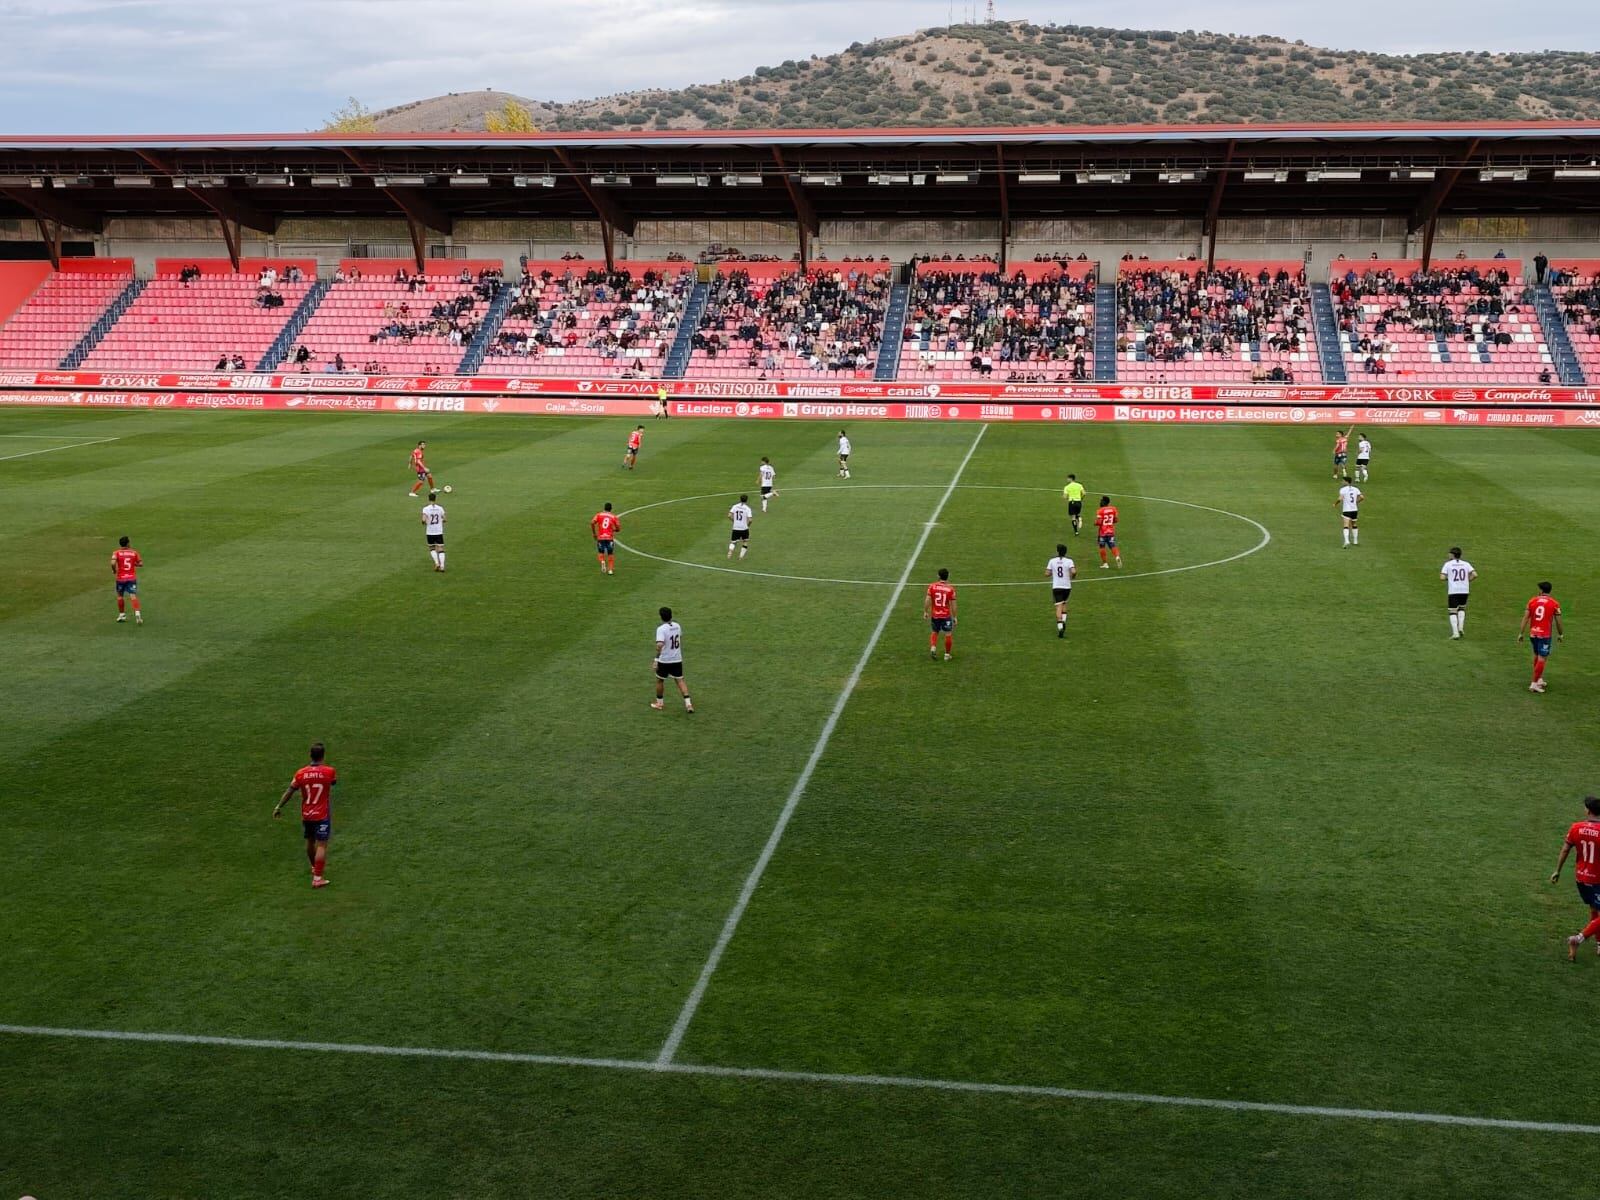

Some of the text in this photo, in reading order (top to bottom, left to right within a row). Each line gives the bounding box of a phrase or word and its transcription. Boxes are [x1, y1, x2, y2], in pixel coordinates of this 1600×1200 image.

[99, 378, 161, 387] TOVAR
[313, 379, 363, 387] INSOCA
[694, 383, 778, 396] PASTISORIA
[787, 384, 841, 397] vinuesa
[1384, 389, 1436, 401] YORK
[86, 394, 128, 404] AMSTEL
[186, 394, 264, 408] #eligeSoria
[545, 402, 566, 412] Caja
[580, 403, 605, 412] Soria
[677, 404, 773, 416] E.Leclerc Soria
[801, 404, 887, 417] Grupo Herce
[981, 405, 1014, 415] SEGUNDA
[1366, 408, 1414, 418] Carrier
[1130, 408, 1225, 421] Grupo Herce
[1226, 409, 1332, 421] E.Leclerc Soria
[1487, 413, 1555, 423] CIUDAD DEL DEPORTE
[430, 514, 439, 525] 23
[735, 510, 744, 521] 15
[1103, 514, 1114, 526] 23
[602, 517, 610, 529] 8
[123, 557, 131, 571] 5
[1057, 566, 1064, 578] 8
[1452, 568, 1466, 582] 20
[935, 592, 947, 607] 21
[1535, 605, 1545, 621] 9
[670, 634, 680, 650] 16
[305, 783, 324, 805] 17
[1580, 840, 1595, 864] 11
